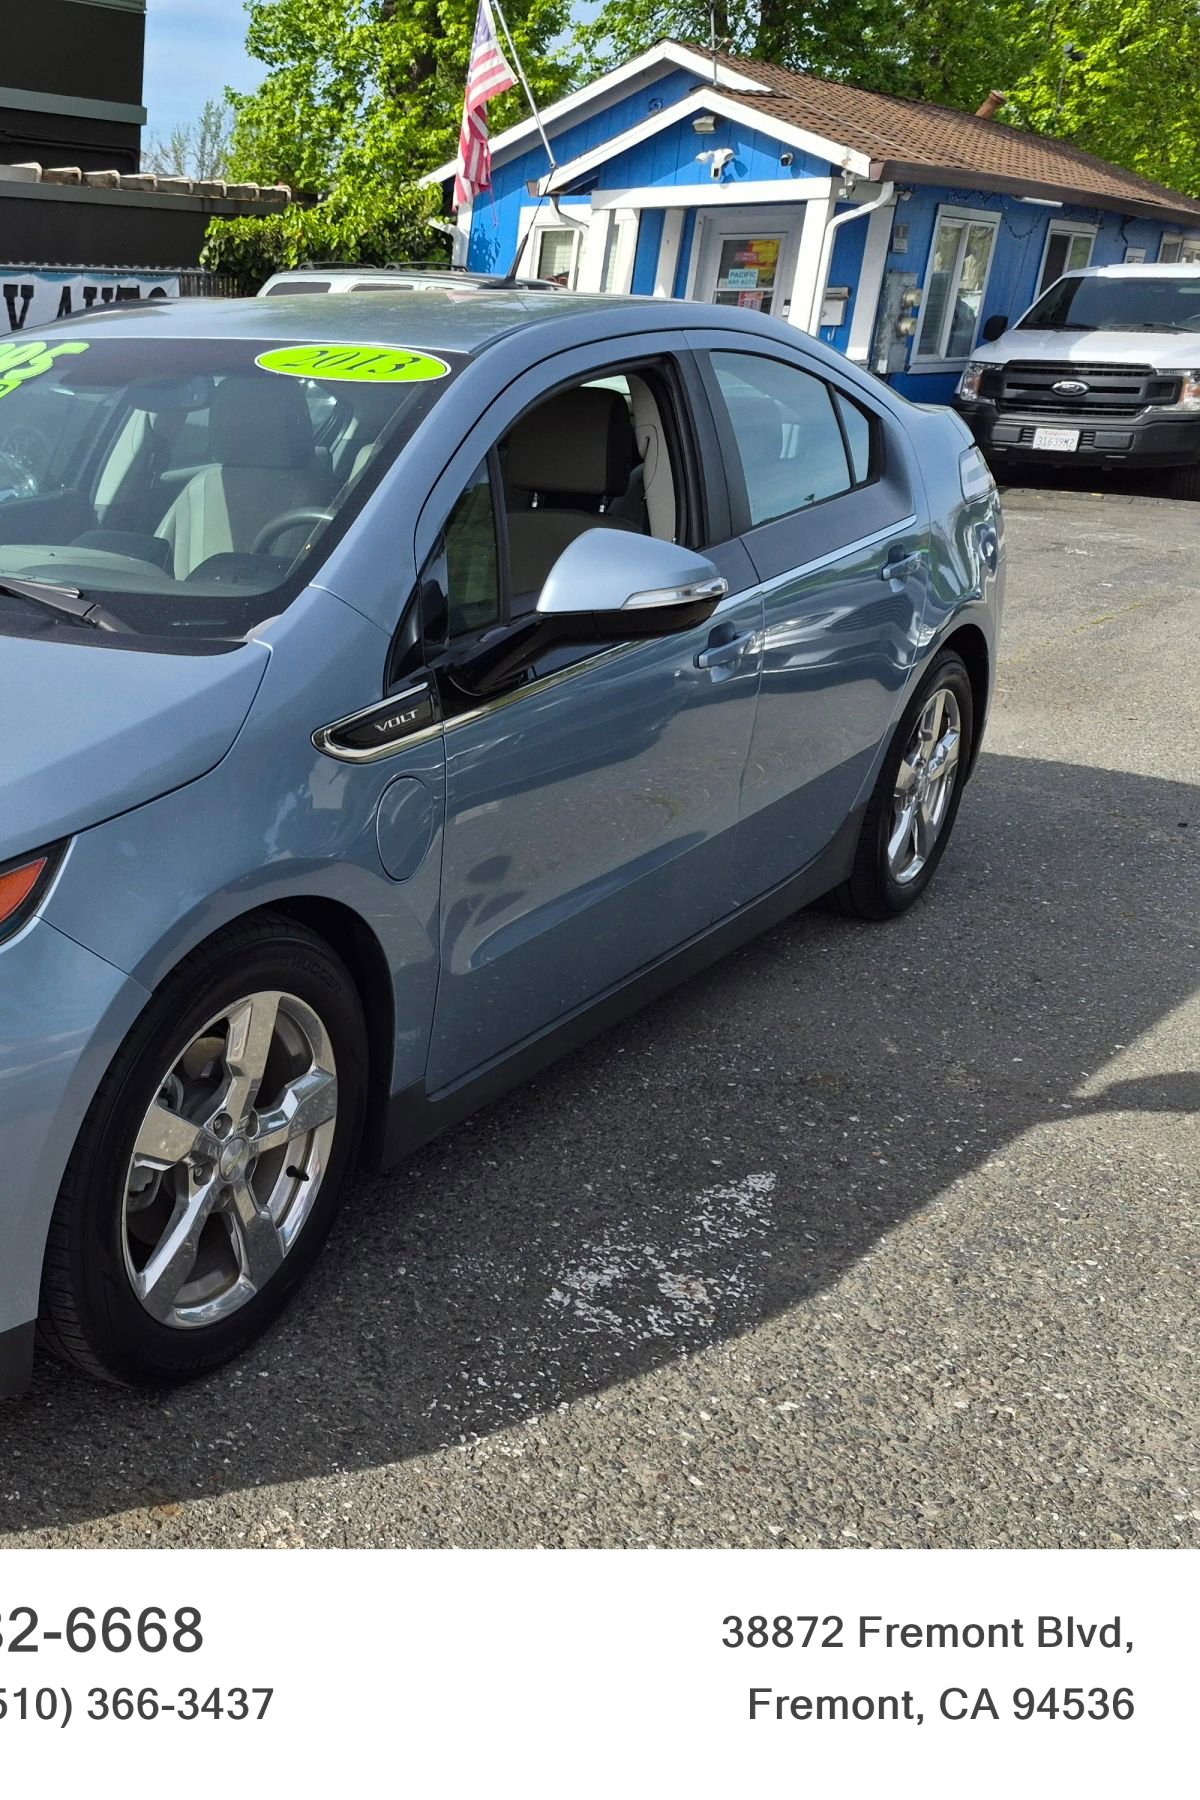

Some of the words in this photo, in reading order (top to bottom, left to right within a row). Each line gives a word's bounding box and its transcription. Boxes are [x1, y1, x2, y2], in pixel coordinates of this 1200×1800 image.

[730, 271, 757, 279] PACIFIC
[280, 350, 422, 375] 2013
[374, 708, 419, 732] VOLT
